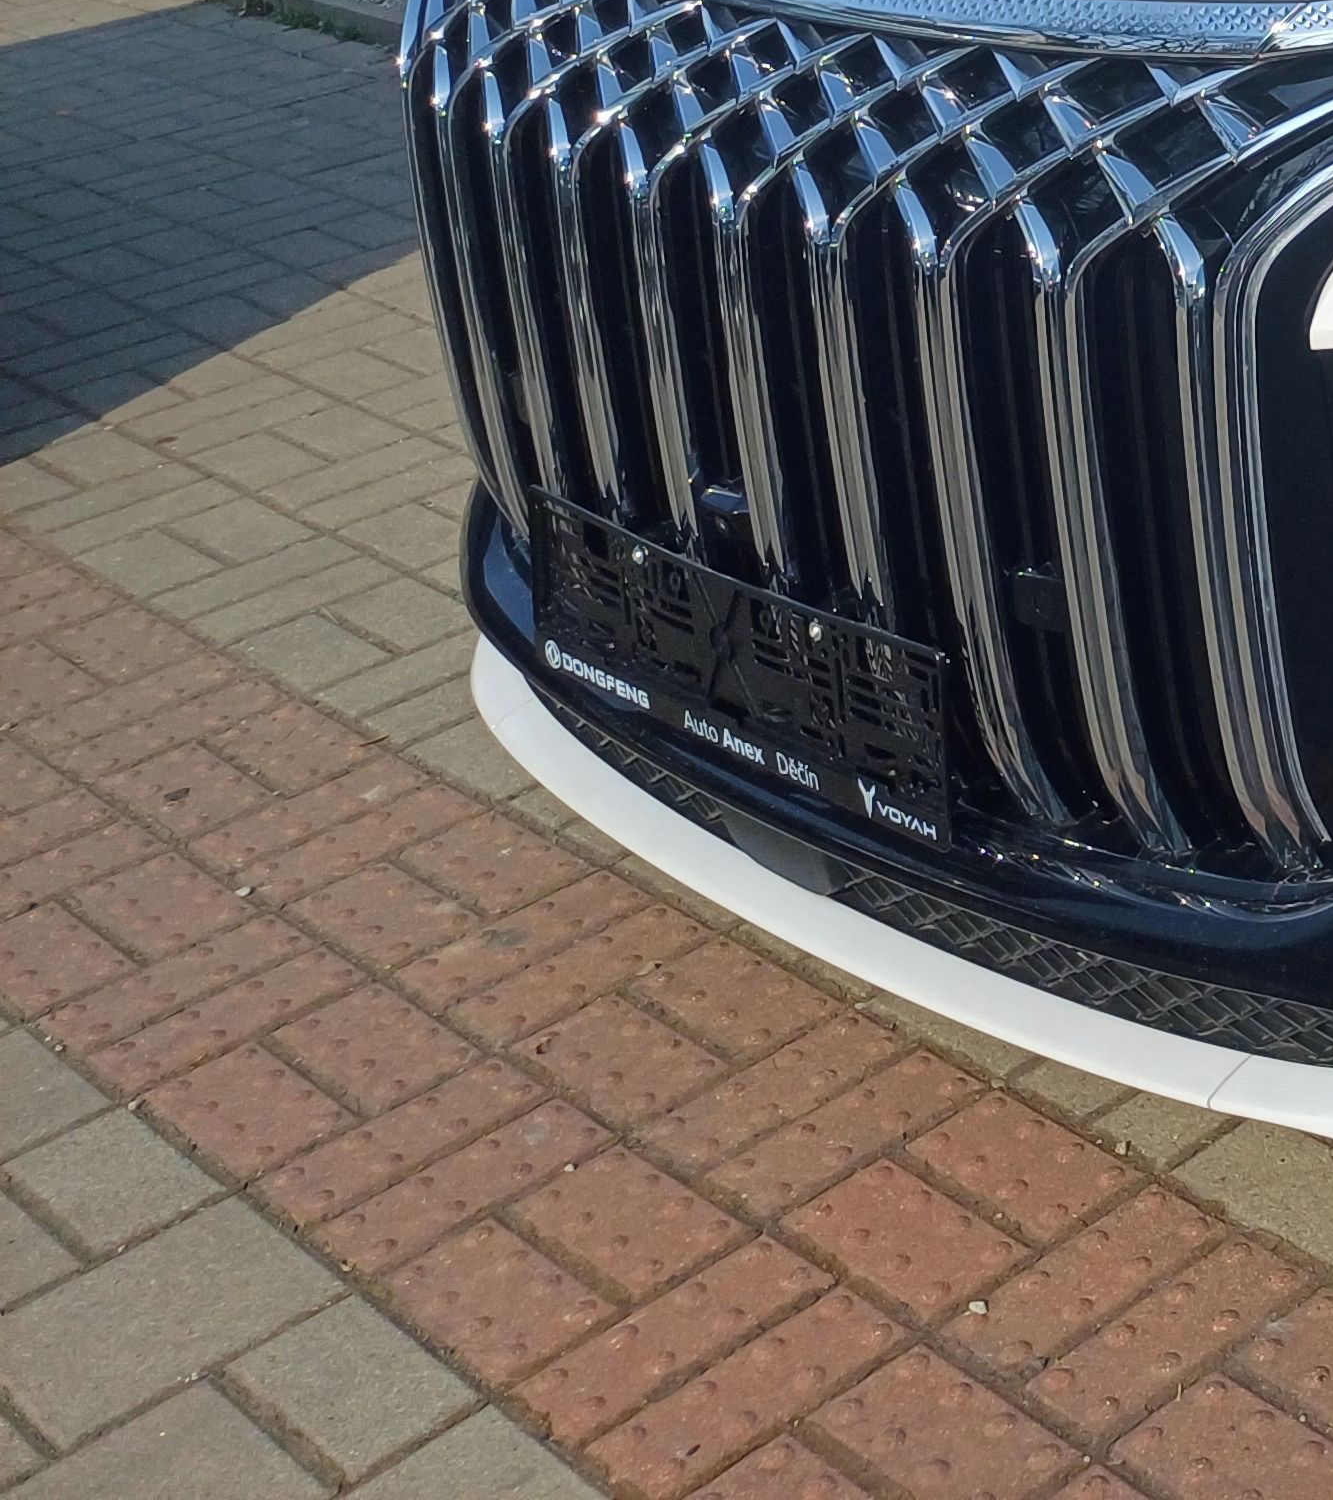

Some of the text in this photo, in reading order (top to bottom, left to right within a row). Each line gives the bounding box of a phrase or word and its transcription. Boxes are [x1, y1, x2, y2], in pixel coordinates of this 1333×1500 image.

[561, 652, 650, 710] DONGFENG
[683, 710, 820, 791] Auto Anex Děčín
[876, 800, 937, 841] VOYAH
